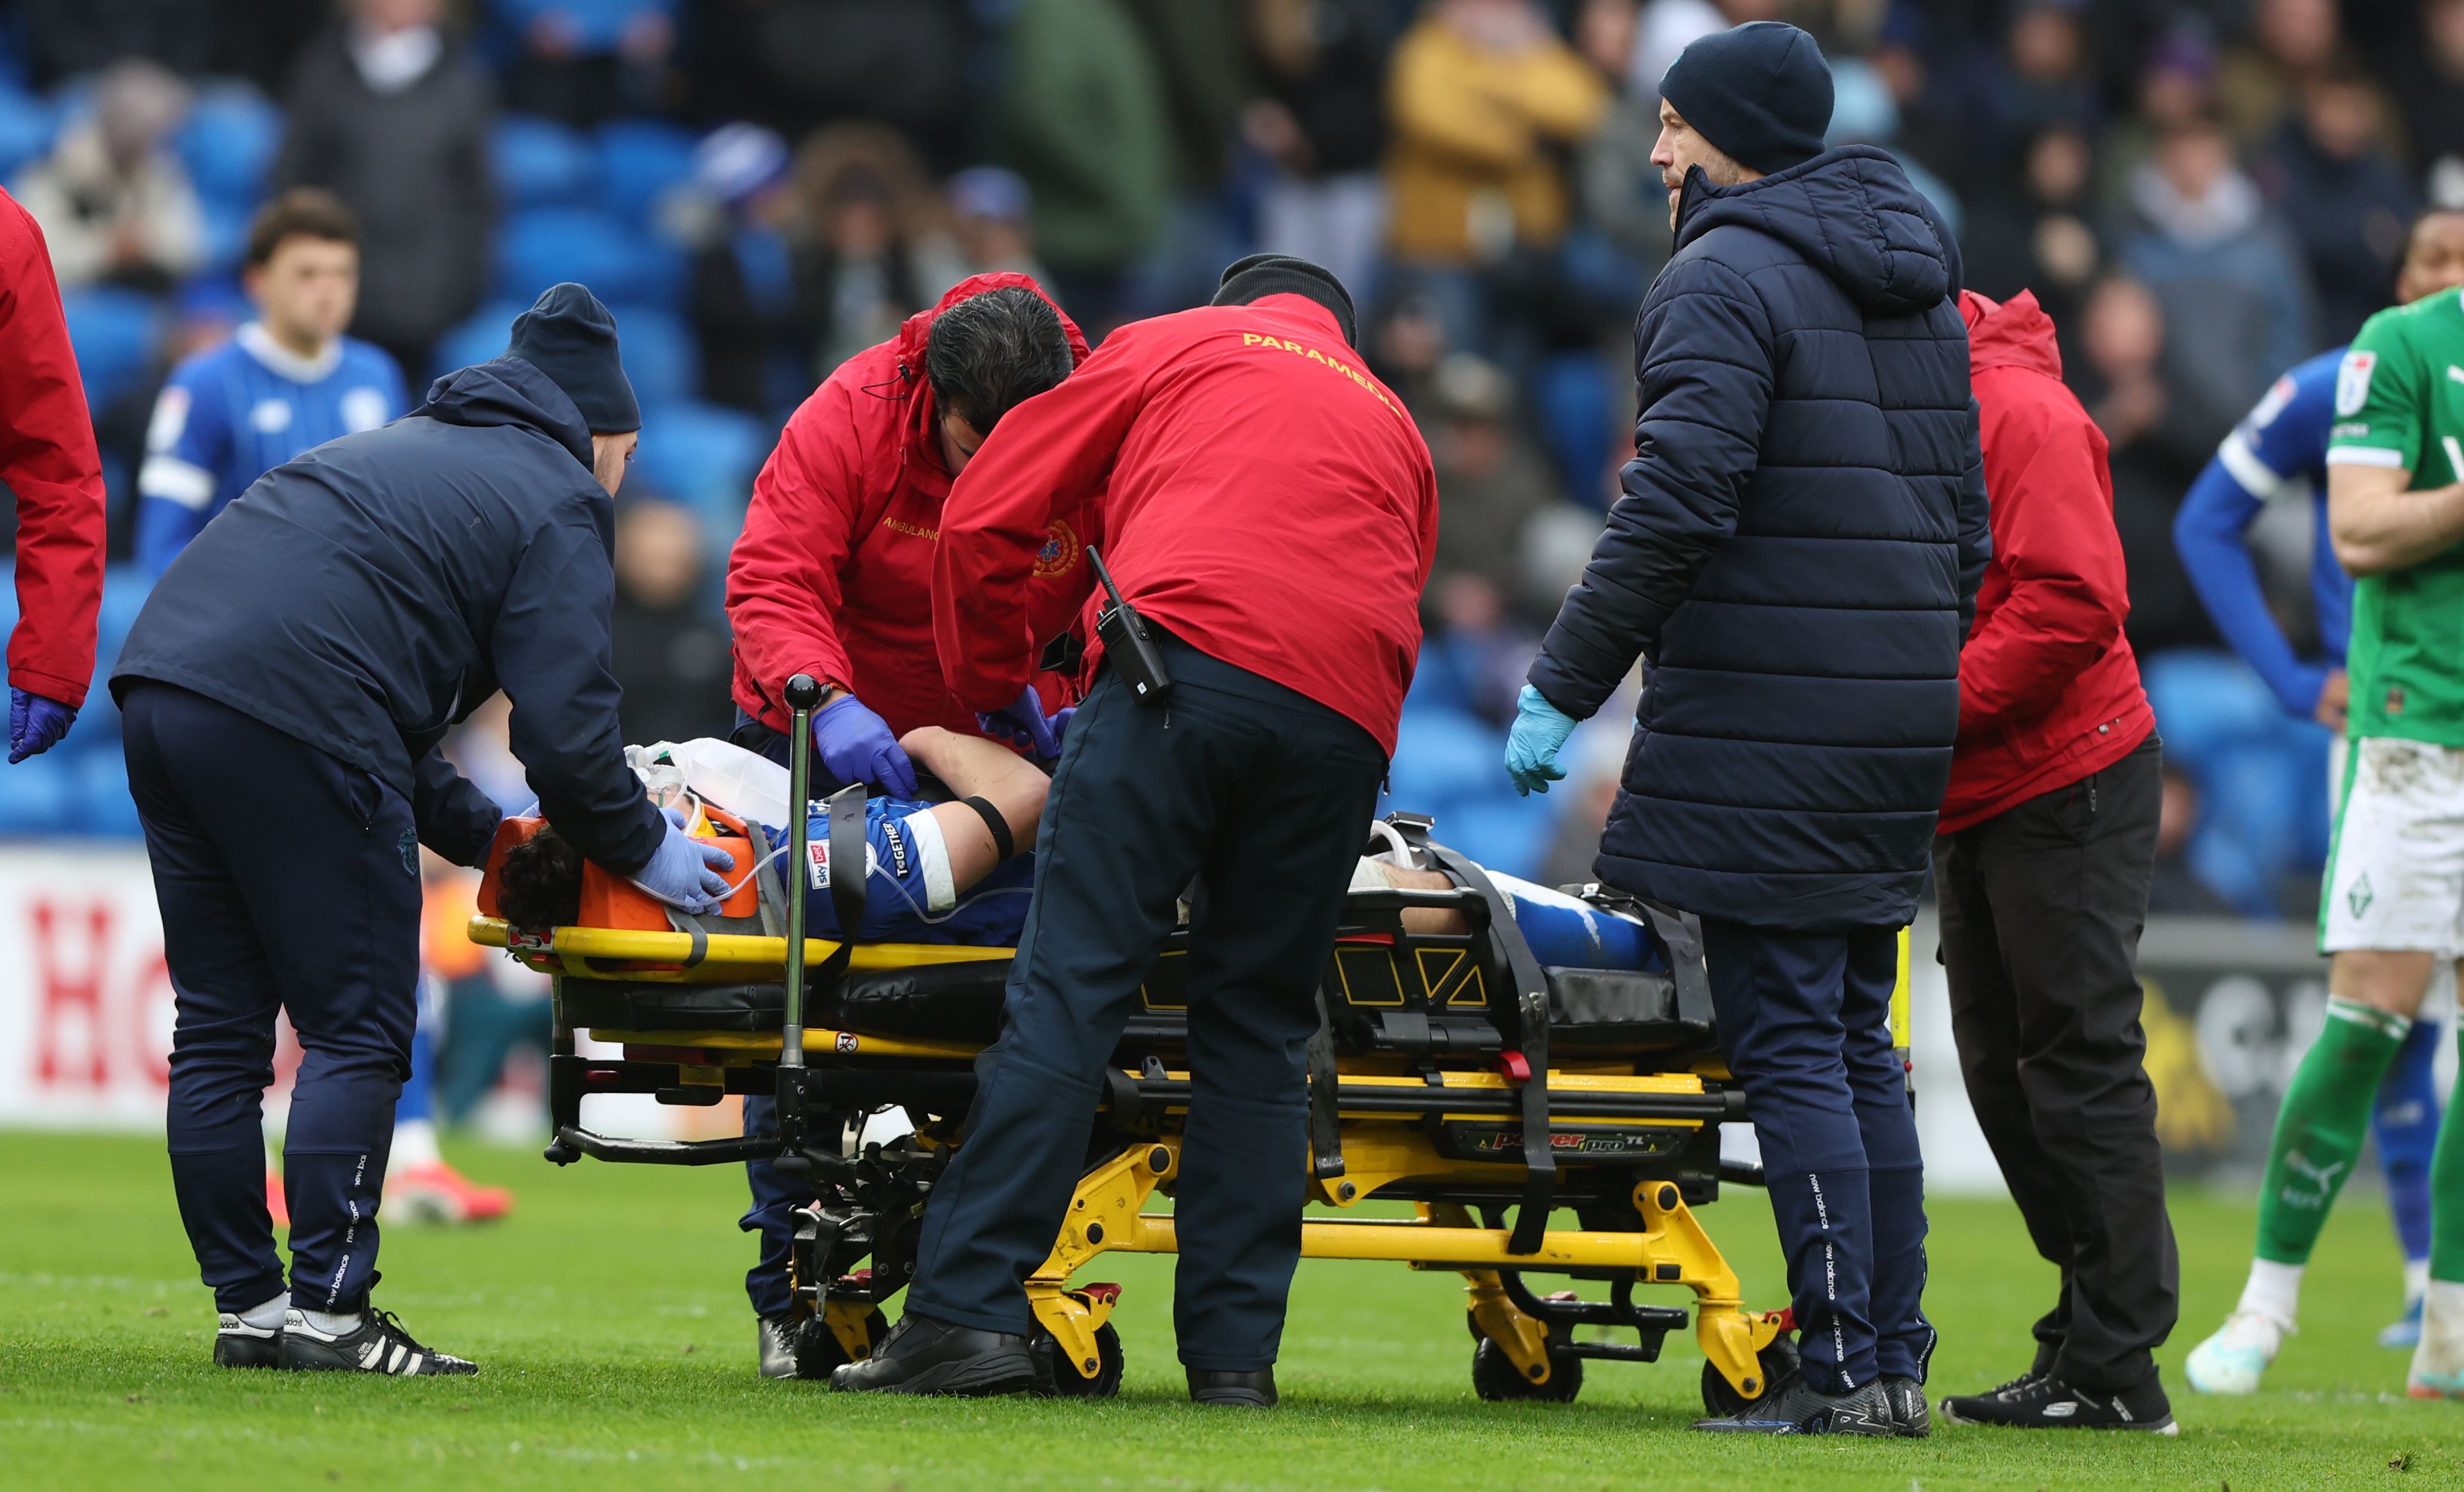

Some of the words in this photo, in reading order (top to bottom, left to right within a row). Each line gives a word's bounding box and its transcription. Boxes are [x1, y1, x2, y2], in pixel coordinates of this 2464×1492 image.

[813, 846, 823, 862] bet
[817, 865, 827, 884] sky
[1582, 1140, 1624, 1153] pro
[1627, 1136, 1643, 1145] TL
[1809, 1174, 1820, 1193] new
[1816, 1193, 1829, 1230] balance
[331, 1254, 349, 1289] balance
[1827, 1261, 1835, 1301] balance
[327, 1289, 337, 1306] new
[1841, 1370, 1855, 1388] new
